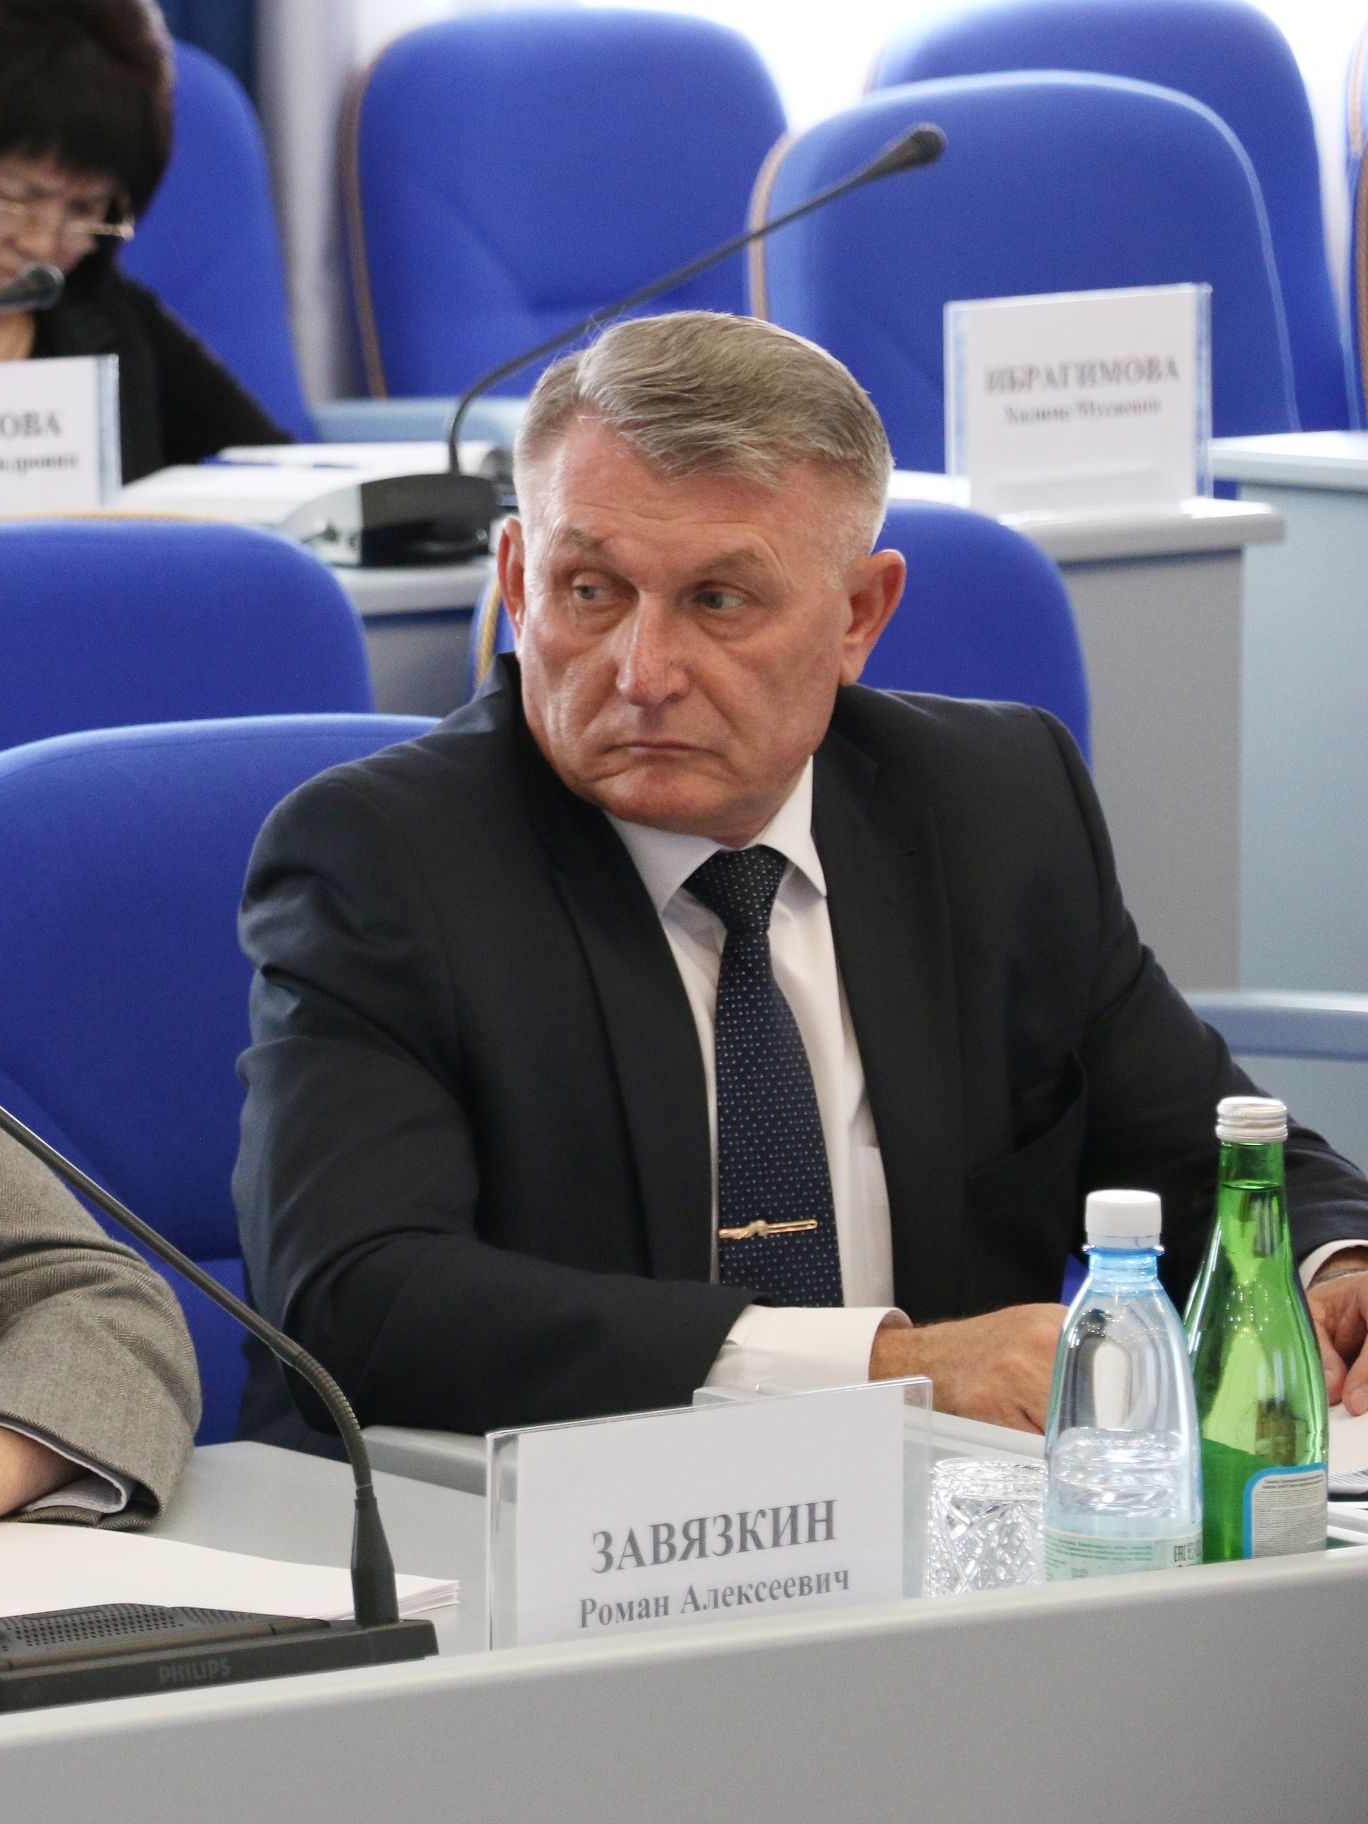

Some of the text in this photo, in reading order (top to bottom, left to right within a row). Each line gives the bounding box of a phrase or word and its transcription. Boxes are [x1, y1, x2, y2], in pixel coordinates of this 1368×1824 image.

[985, 355, 1180, 393] ИБРАГИМОВА
[591, 1499, 838, 1575] ЗАВЯЗКИН
[578, 1569, 850, 1629] Роман Алексеевич
[158, 1657, 231, 1684] PHILIPS
